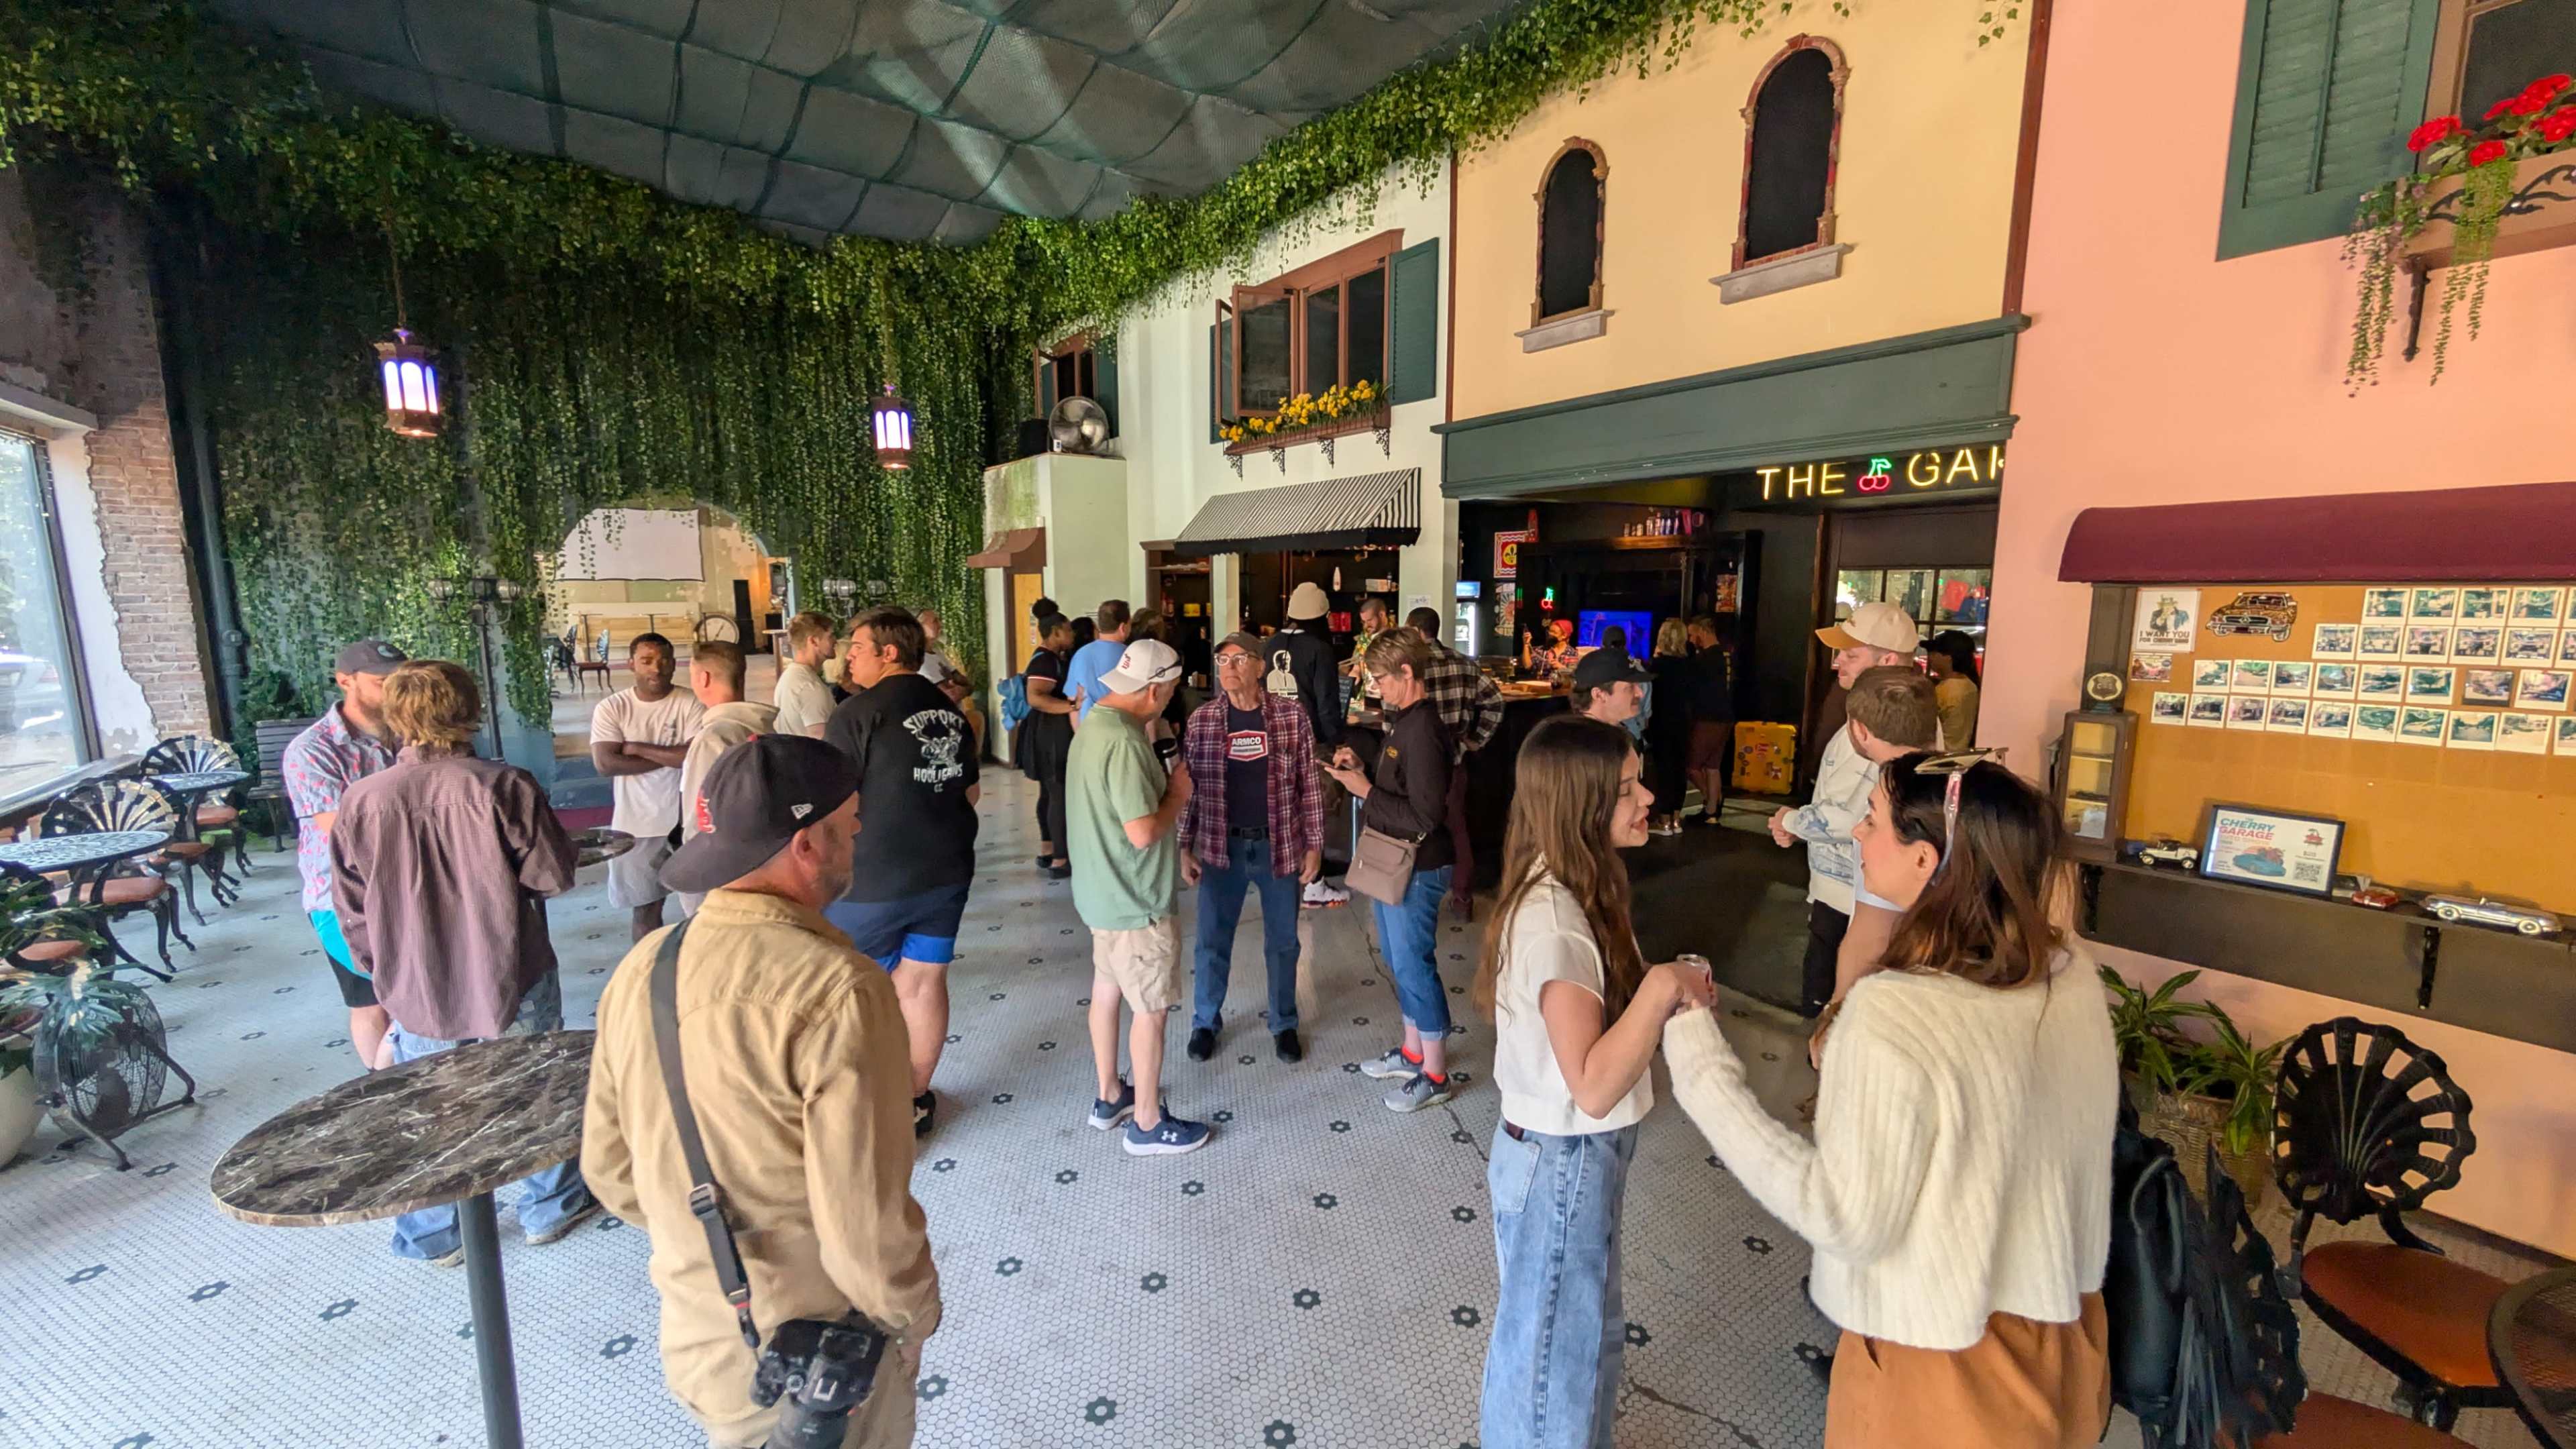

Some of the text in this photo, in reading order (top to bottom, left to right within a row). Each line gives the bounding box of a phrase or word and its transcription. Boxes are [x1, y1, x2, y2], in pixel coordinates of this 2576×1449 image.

[1756, 462, 1846, 500] THE
[902, 710, 965, 735] SUPPORT
[1232, 737, 1261, 745] ARMCO
[913, 763, 963, 784] HOOLIGANS
[2218, 826, 2275, 841] GARAGE
[2220, 818, 2276, 832] CHERRY
